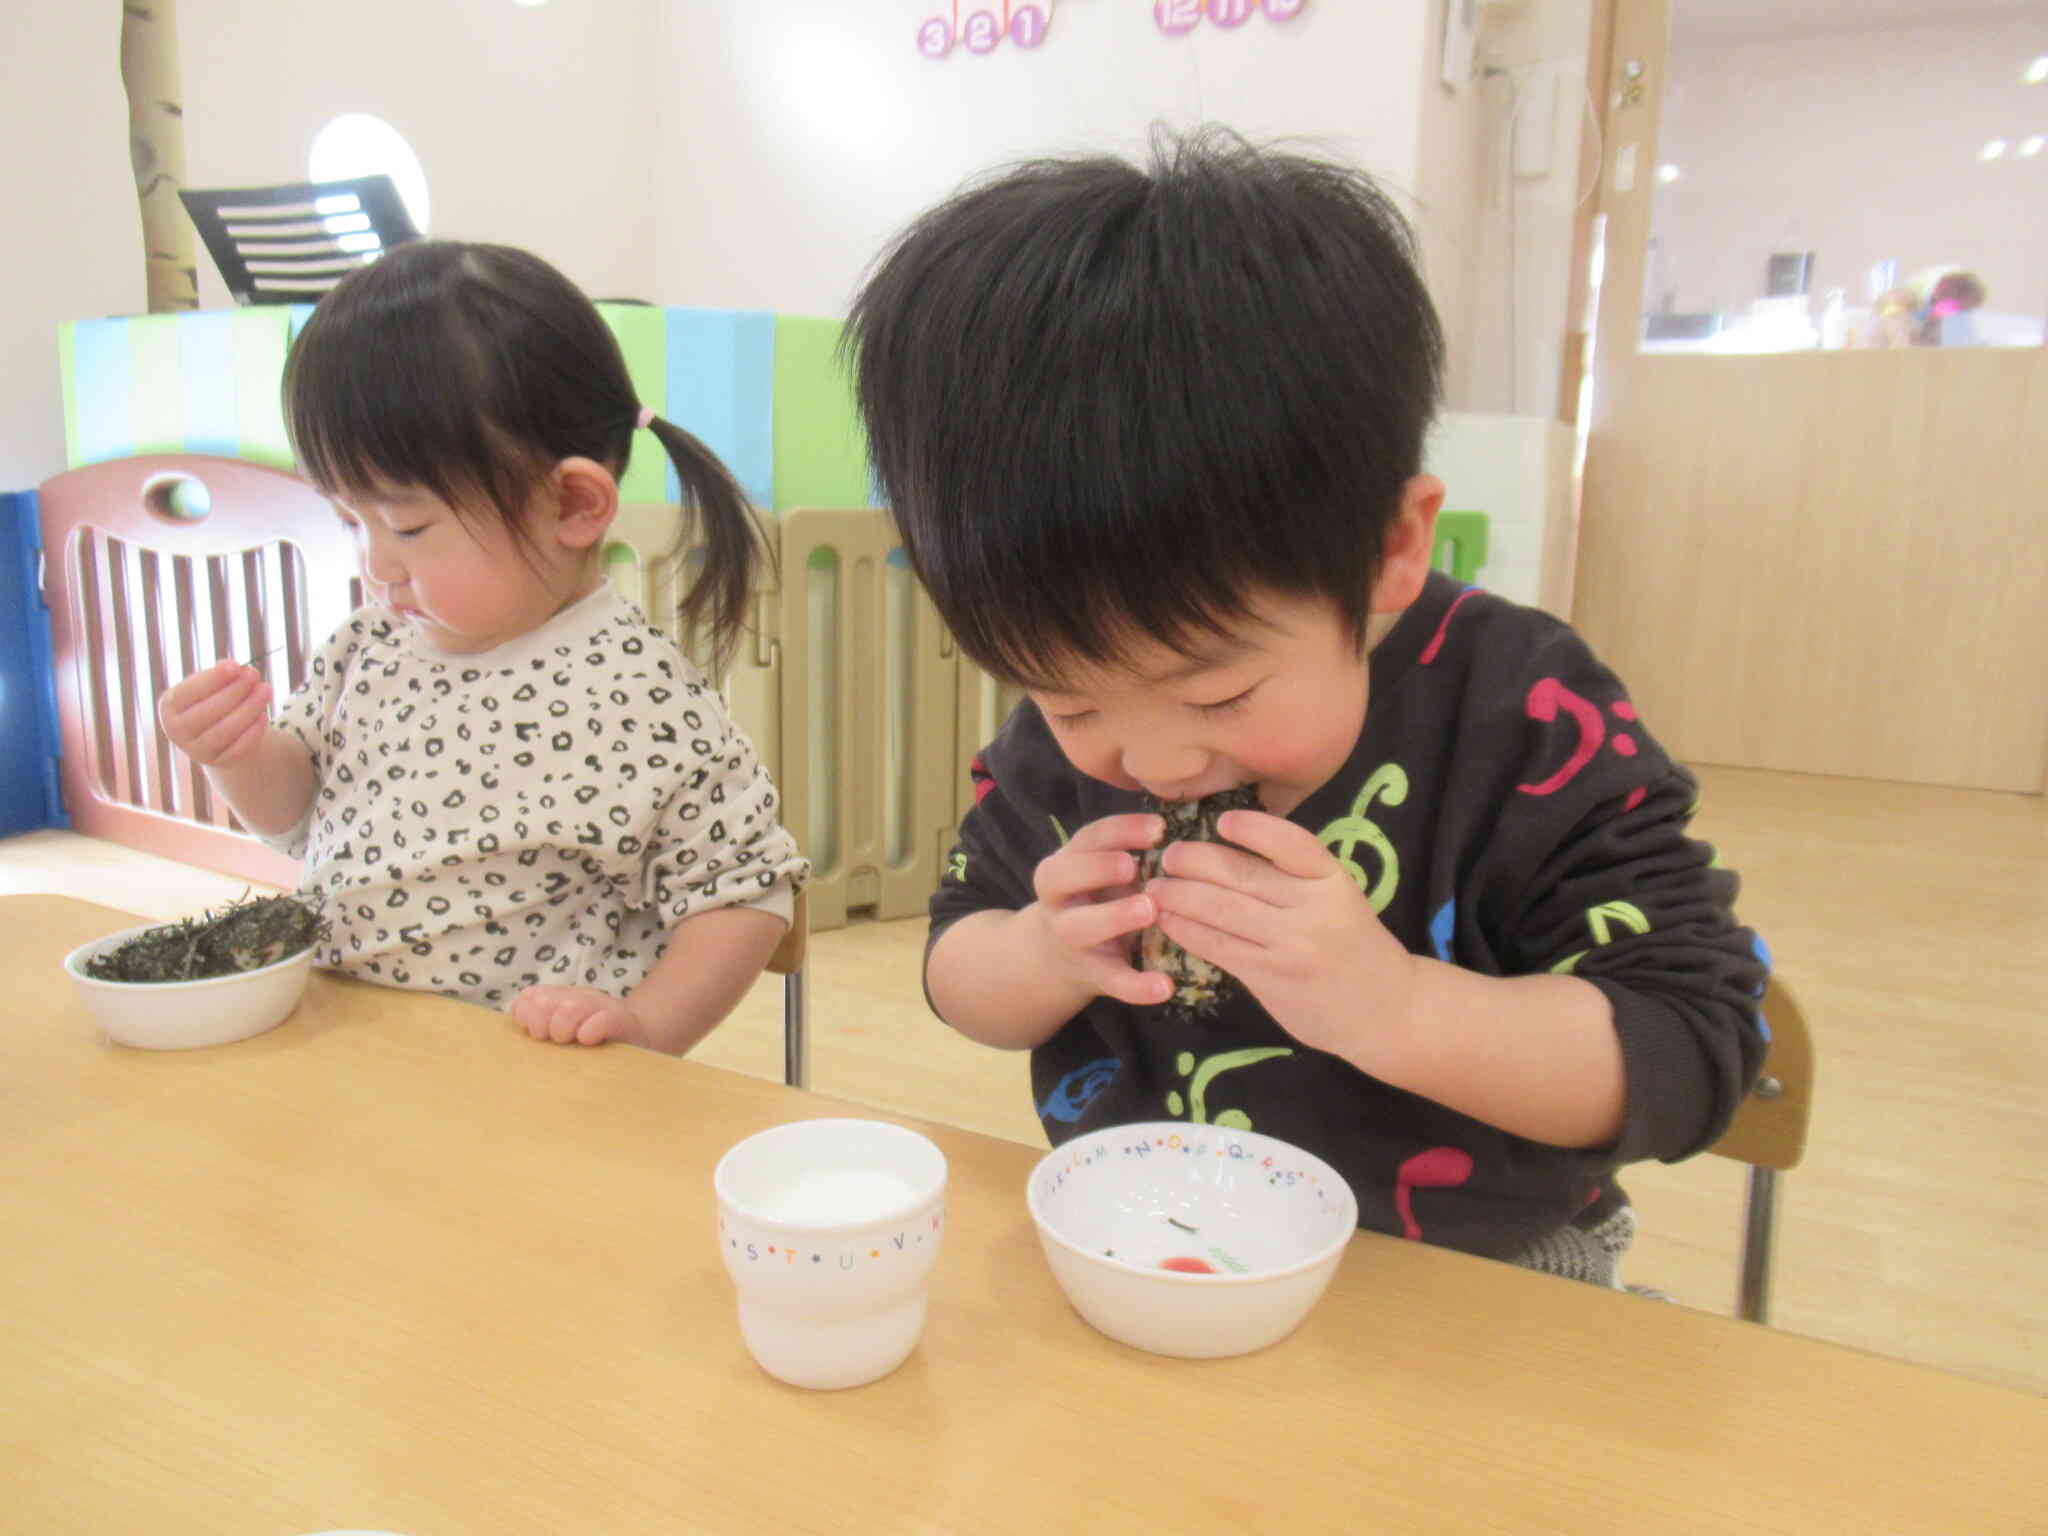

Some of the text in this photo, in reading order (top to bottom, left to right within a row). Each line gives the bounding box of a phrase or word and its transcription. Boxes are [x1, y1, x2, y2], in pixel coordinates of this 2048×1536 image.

[925, 8, 1034, 55] 3 2 1
[1229, 1143, 1243, 1159] Q
[746, 1242, 759, 1262] S
[783, 1247, 796, 1265] T
[839, 1251, 854, 1271] U
